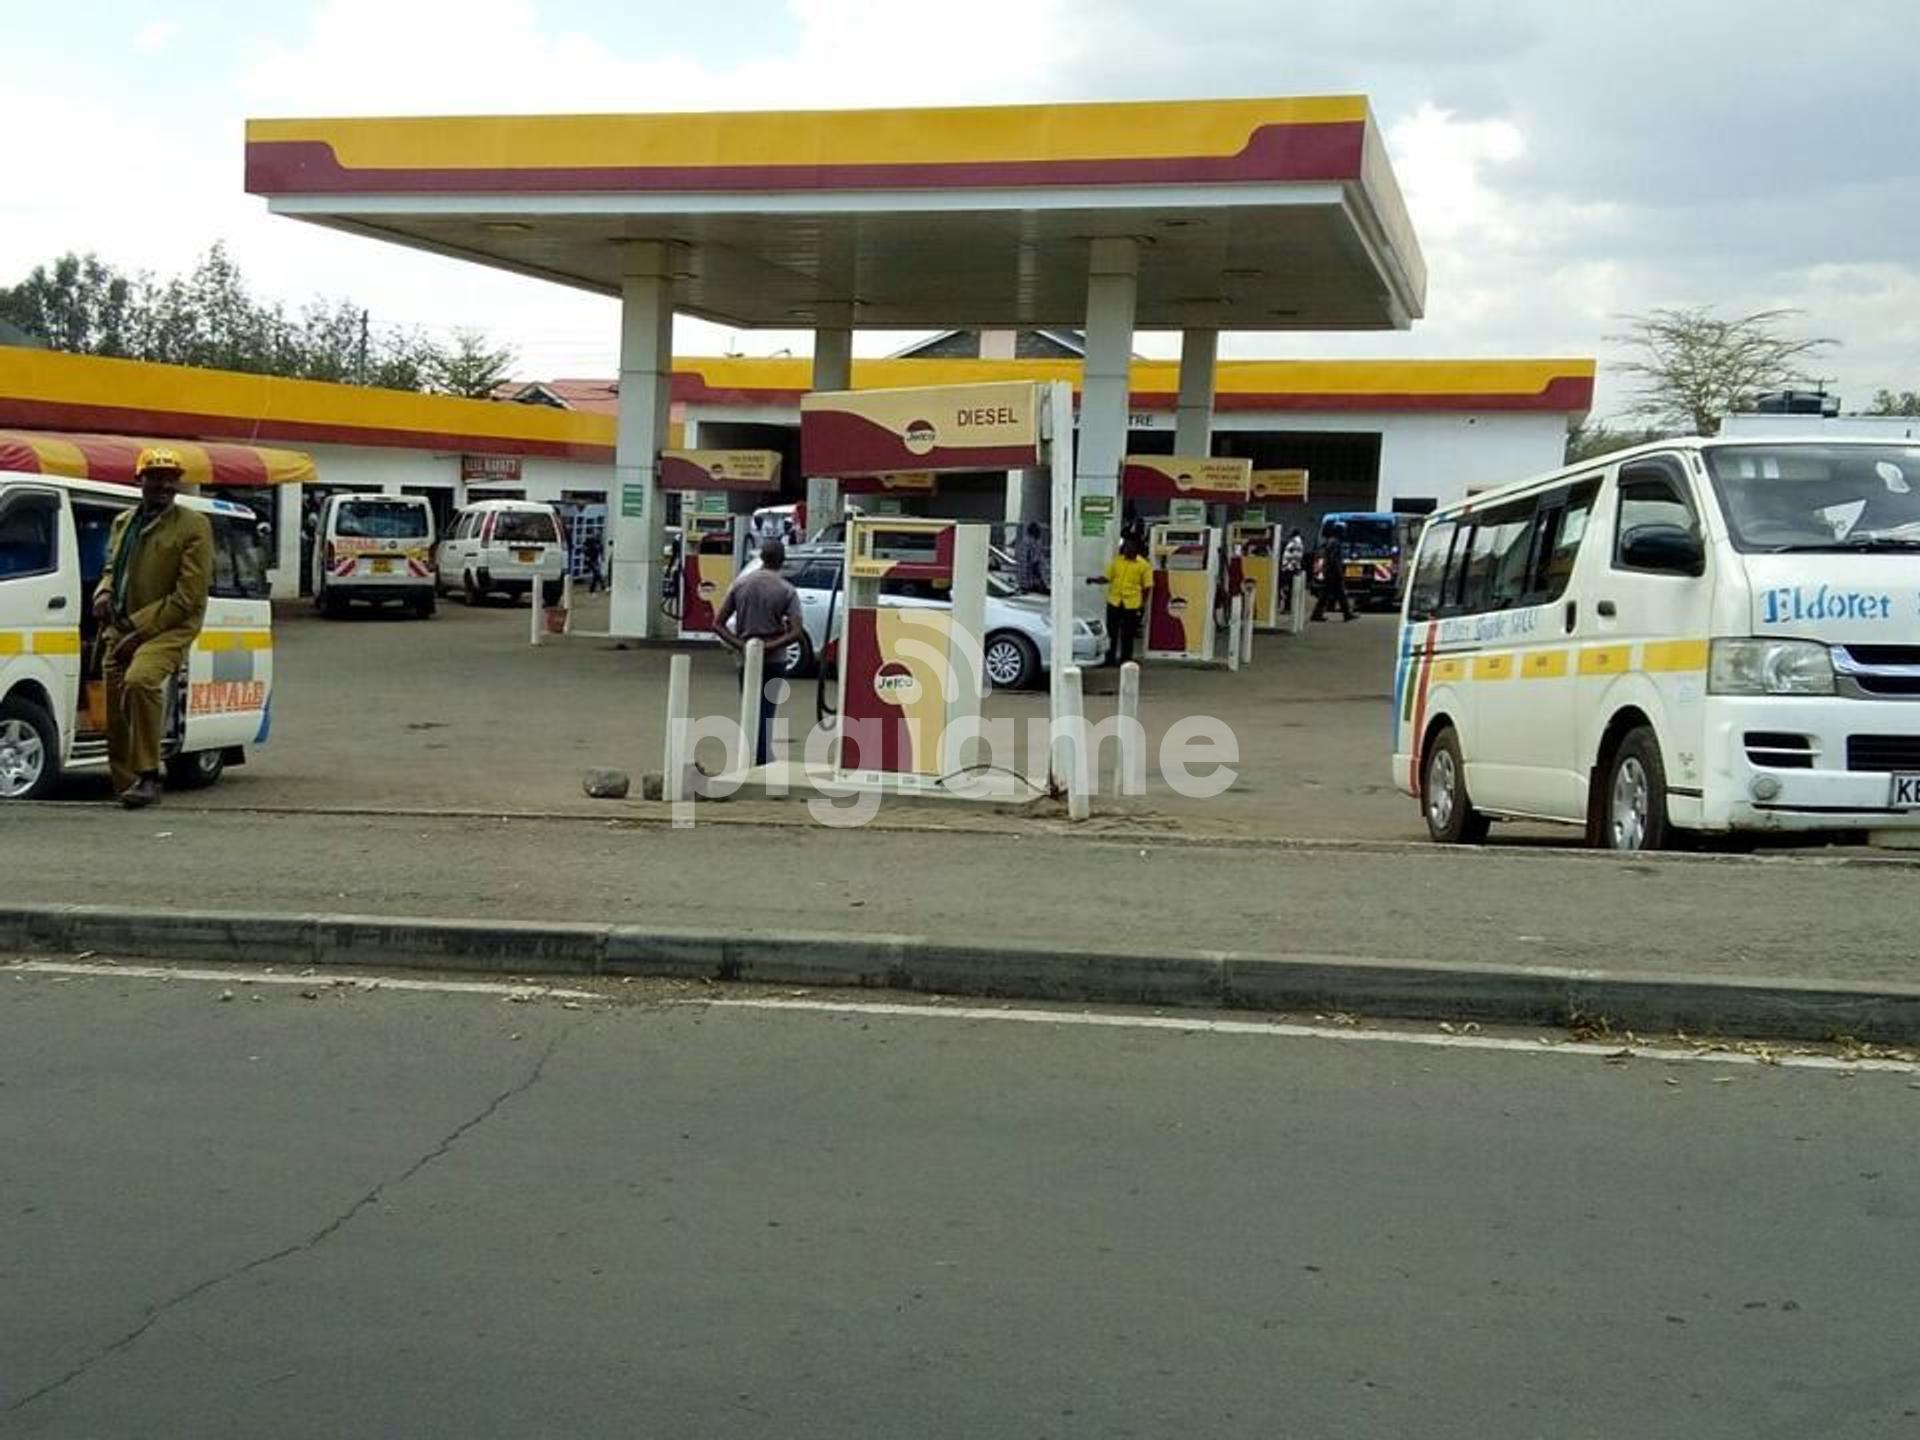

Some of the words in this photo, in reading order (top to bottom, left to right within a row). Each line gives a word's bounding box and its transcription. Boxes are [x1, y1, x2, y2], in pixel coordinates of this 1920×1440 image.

[957, 407, 1018, 427] DIESEL
[1760, 584, 1890, 623] Eldoret
[190, 681, 265, 714] KITALE
